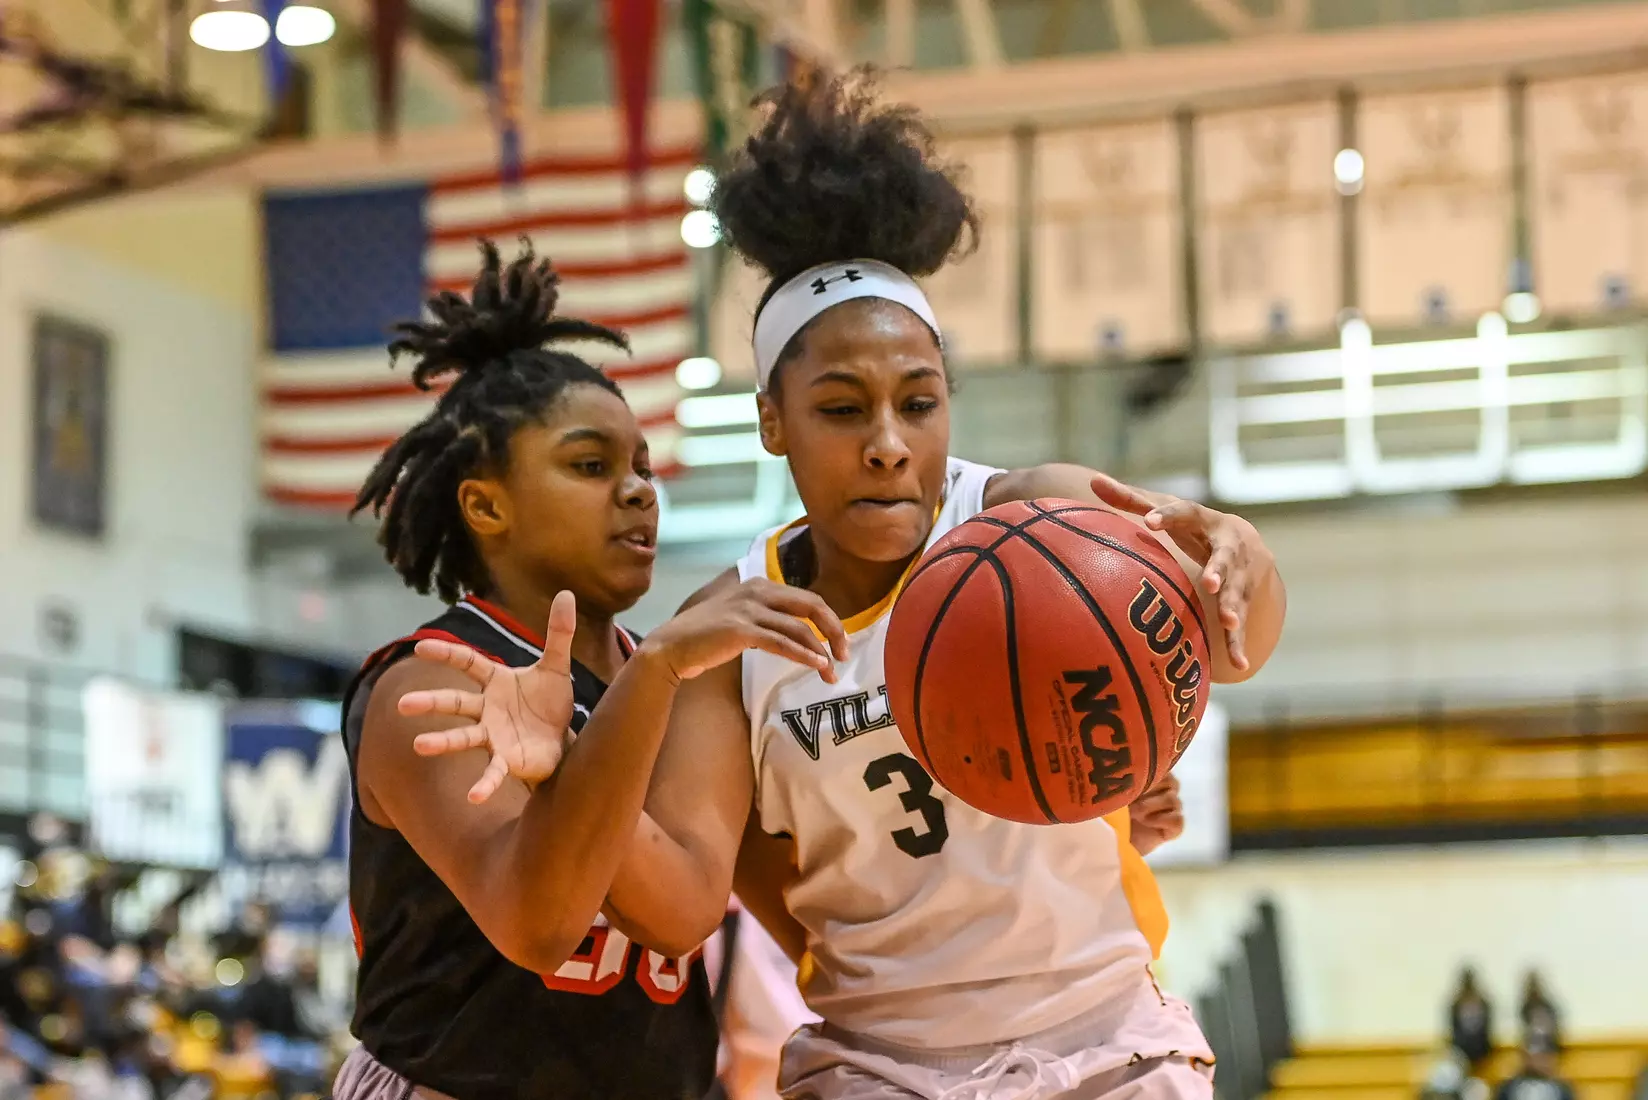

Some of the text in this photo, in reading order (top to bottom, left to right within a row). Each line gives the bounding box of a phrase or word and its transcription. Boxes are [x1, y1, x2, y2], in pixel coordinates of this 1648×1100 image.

[781, 684, 896, 760] VIL
[1061, 665, 1134, 805] NCAA
[1127, 576, 1202, 772] Wilso
[863, 752, 949, 859] 3
